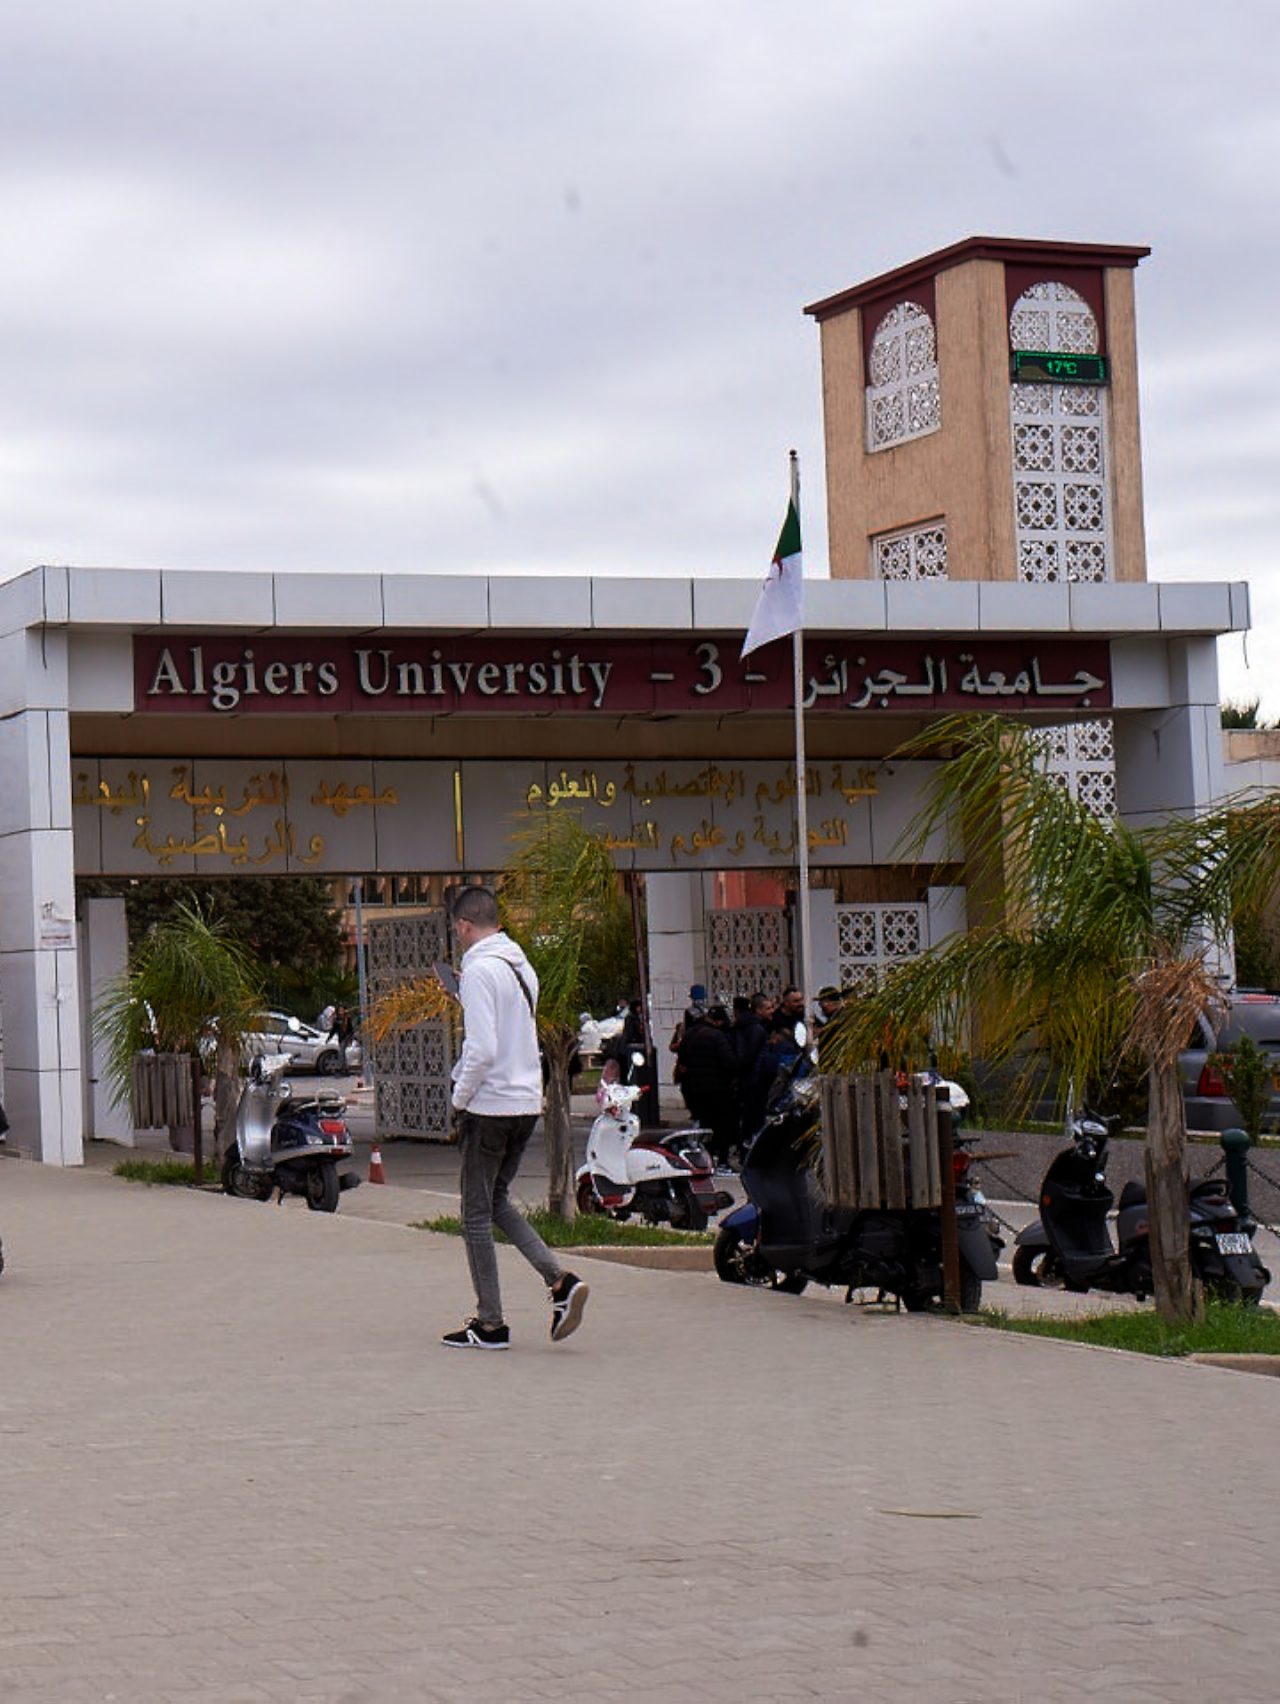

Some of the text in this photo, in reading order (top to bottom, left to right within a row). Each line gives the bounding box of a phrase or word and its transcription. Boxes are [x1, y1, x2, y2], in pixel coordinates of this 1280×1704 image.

[147, 647, 339, 710] Algiers
[354, 648, 614, 708] University
[693, 642, 723, 695] 3
[802, 652, 1106, 709] جامعة الجزائر
[169, 765, 290, 817] التربية
[311, 778, 400, 818] معهد
[526, 769, 617, 810] والعلوم
[831, 764, 880, 805] كلية
